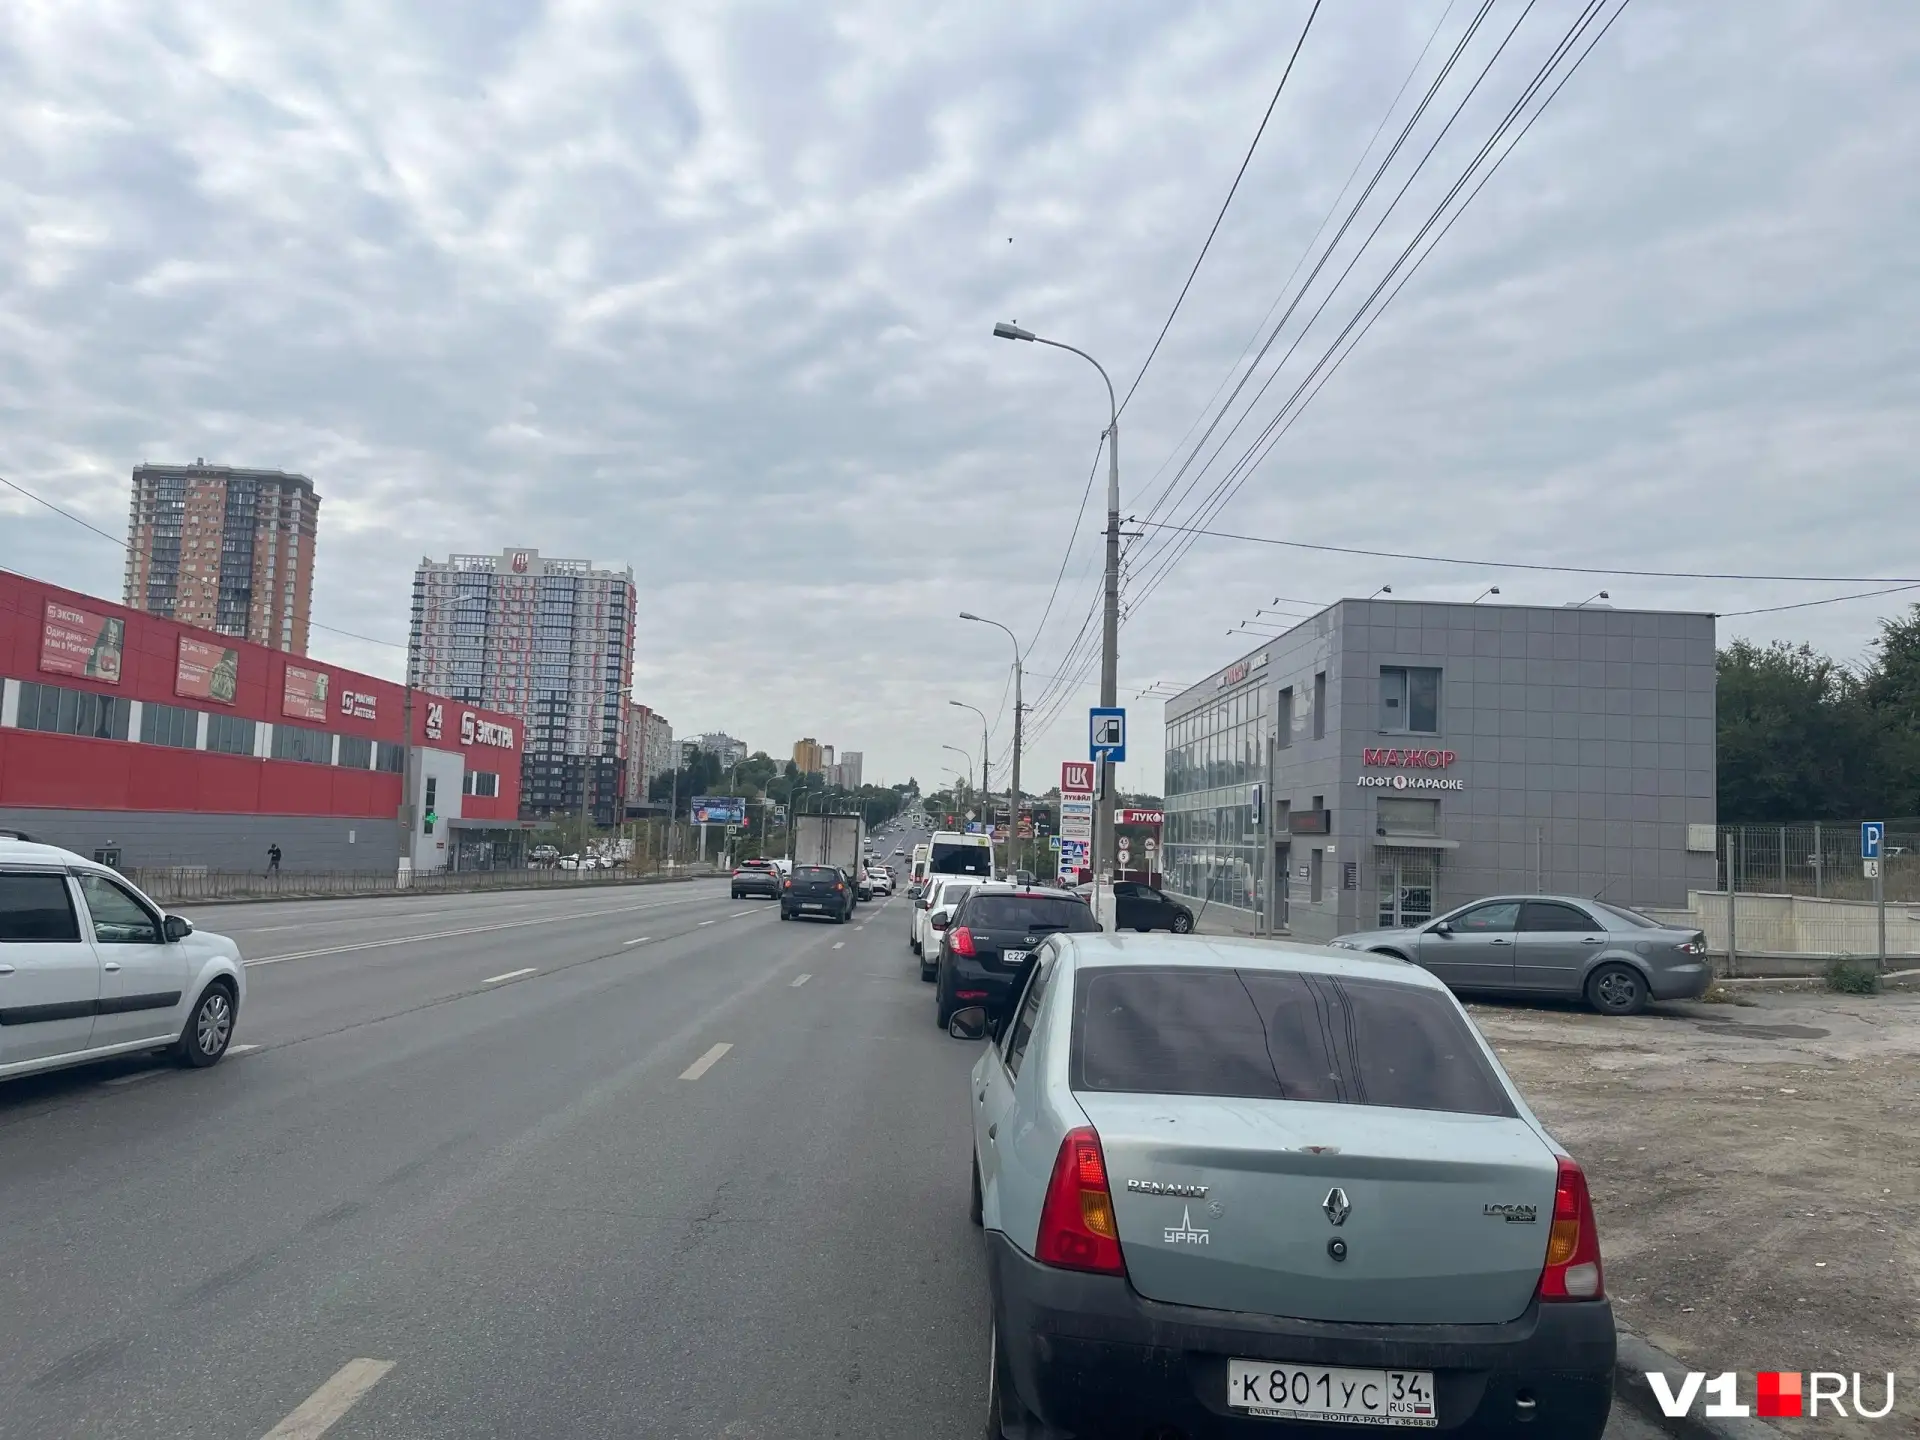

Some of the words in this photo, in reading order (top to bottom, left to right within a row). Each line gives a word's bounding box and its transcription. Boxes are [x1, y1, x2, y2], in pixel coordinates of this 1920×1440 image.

[57, 608, 84, 624] ЭКСТРА
[46, 625, 65, 639] Один
[65, 631, 82, 643] день
[66, 641, 95, 656] Магните
[426, 702, 443, 729] 24
[475, 719, 514, 750] ЭКСТРА
[1363, 747, 1456, 769] МАЖОР
[1357, 776, 1392, 787] ЛОФТ
[1408, 777, 1464, 790] КАРАОКЕ
[1130, 811, 1165, 823] ЛУКО
[1127, 1179, 1210, 1200] RENAULT
[1483, 1203, 1537, 1216] LOGAN
[1164, 1231, 1209, 1245] УРАЛ
[1391, 1373, 1422, 1402] 34
[1389, 1402, 1414, 1413] RUS
[1322, 1413, 1392, 1426] ВОЛГА-РАСТ
